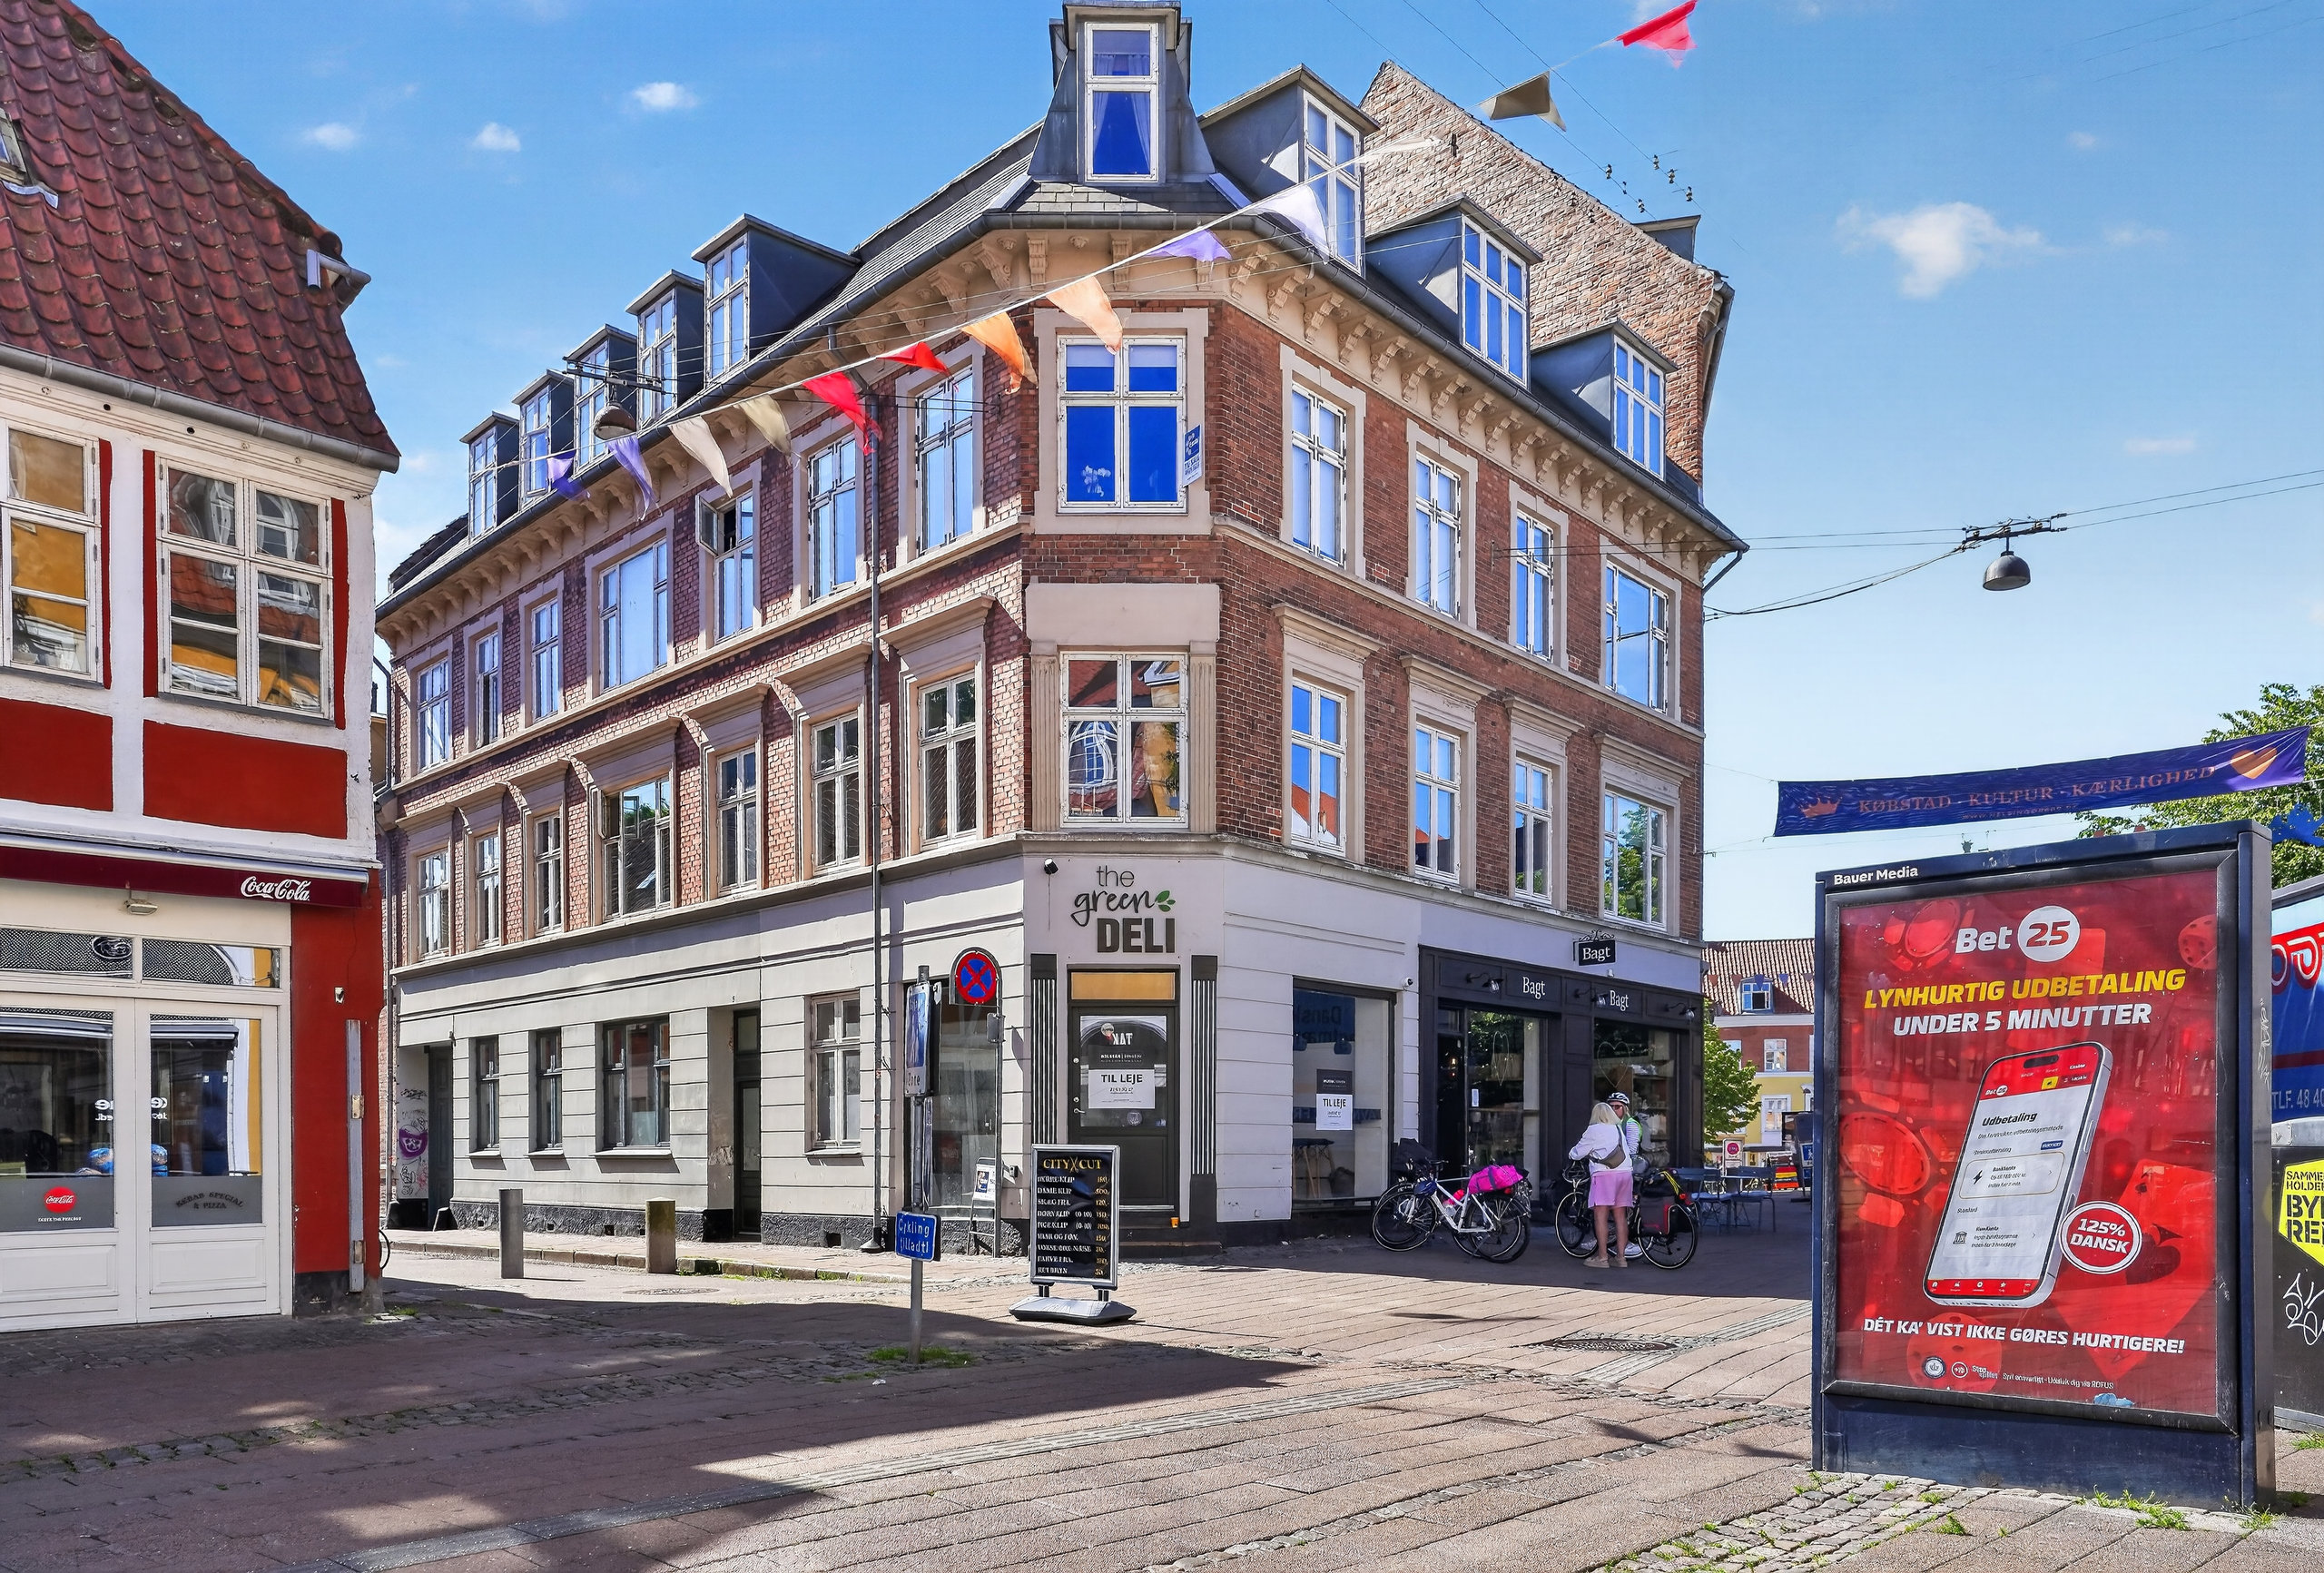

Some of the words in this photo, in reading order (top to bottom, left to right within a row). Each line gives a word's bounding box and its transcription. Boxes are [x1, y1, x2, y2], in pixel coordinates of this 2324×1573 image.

[1858, 795, 1951, 813] KØBSTAD
[1968, 787, 2053, 806] KULTUR
[2072, 766, 2216, 797] KÆRLIGHED
[1096, 865, 1135, 888] the
[1834, 872, 1874, 885] Bauer
[1876, 866, 1919, 880] Media
[241, 876, 311, 901] Coca-Cola
[1070, 890, 1156, 927] green
[1097, 918, 1176, 953] DELI
[1955, 926, 2012, 954] Bet
[2026, 920, 2071, 948] 25
[1582, 947, 1611, 961] Bagt
[1522, 977, 1546, 999] Bagt
[1864, 981, 2005, 1009] LYNHURTIG
[2012, 968, 2187, 1000] UDBETALING
[1610, 990, 1629, 1011] Bagt
[1893, 1012, 1980, 1037] UNDER
[1984, 1010, 2003, 1032] 5
[2007, 1003, 2152, 1031] MINUTTER
[1101, 1074, 1118, 1083] TIL
[1120, 1074, 1143, 1085] LEJE
[1323, 1098, 1333, 1107] TIL
[1333, 1098, 1346, 1109] LEJE
[2272, 1090, 2293, 1109] TLF.
[2297, 1088, 2310, 1108] 48
[1982, 1113, 2038, 1126] Udbetaling
[1043, 1159, 1069, 1170] CITY
[1078, 1159, 1102, 1170] CUT
[2077, 1218, 2126, 1237] 125%
[2069, 1234, 2130, 1254] DANSK
[1926, 1322, 1964, 1338] VIST
[1966, 1324, 2006, 1341] IKKE
[2009, 1327, 2068, 1345] GØRES
[2072, 1332, 2186, 1355] HURTIGERE!
